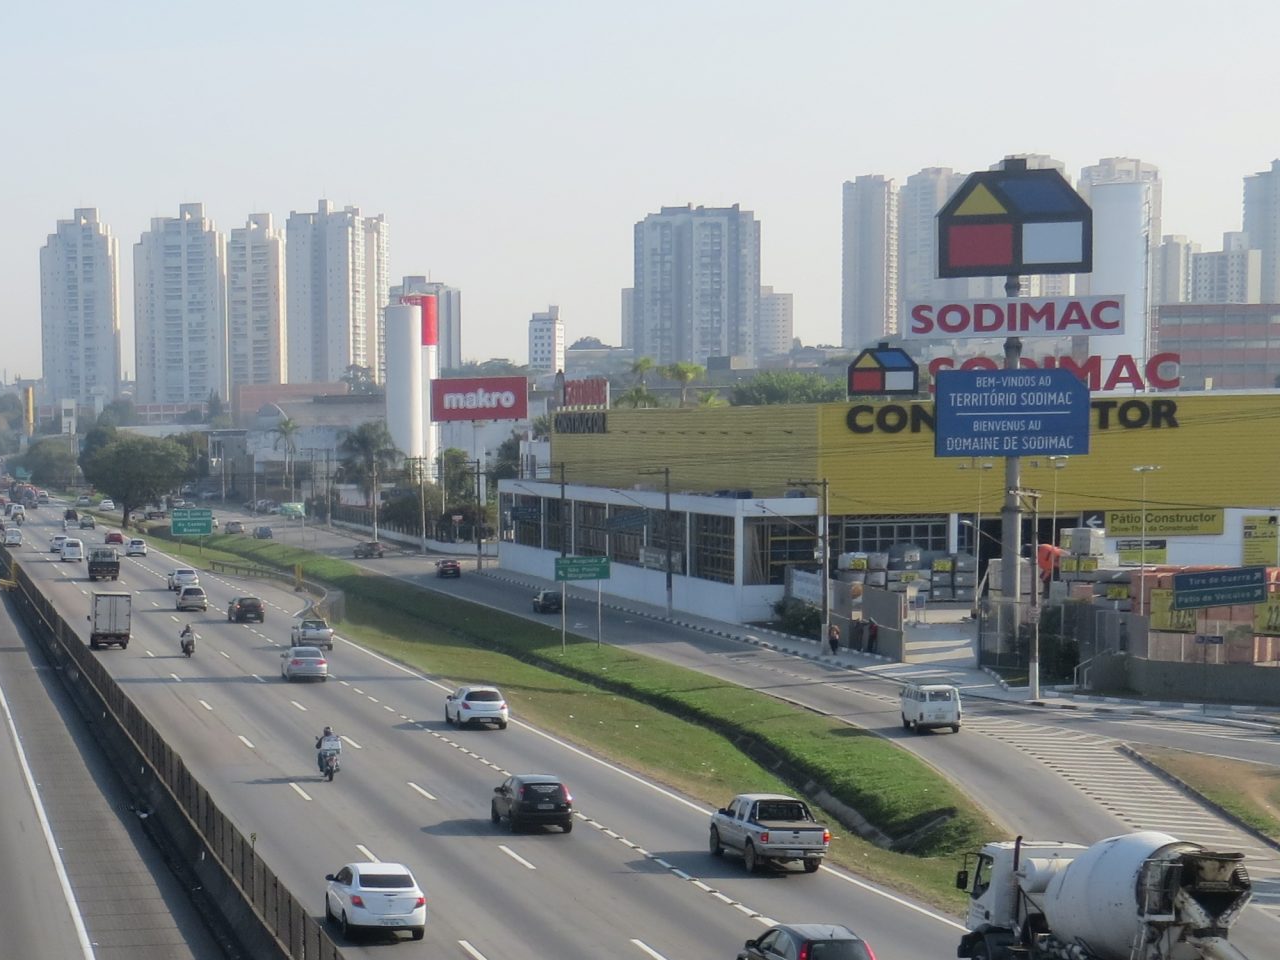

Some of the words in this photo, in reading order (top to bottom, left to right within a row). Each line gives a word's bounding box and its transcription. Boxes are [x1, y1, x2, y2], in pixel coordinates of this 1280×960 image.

[910, 300, 1120, 334] SODIMAC
[976, 376, 1036, 388] BEM-VINDOS
[1038, 376, 1051, 386] AO
[443, 388, 515, 410] makro
[949, 389, 1017, 407] TERRITÓRIO
[1020, 391, 1073, 406] SODIMAC
[846, 399, 1179, 434] CONTOR
[973, 420, 1026, 432] BIENVENUS
[1028, 420, 1041, 430] AU
[946, 437, 1000, 451] DOMAINE
[1003, 436, 1019, 450] DE
[1022, 435, 1074, 450] SODIMAC
[1110, 513, 1141, 524] Pátio
[1144, 512, 1217, 524] Constructor
[1208, 576, 1219, 584] de
[1221, 573, 1252, 583] Guerra
[1202, 593, 1213, 602] de
